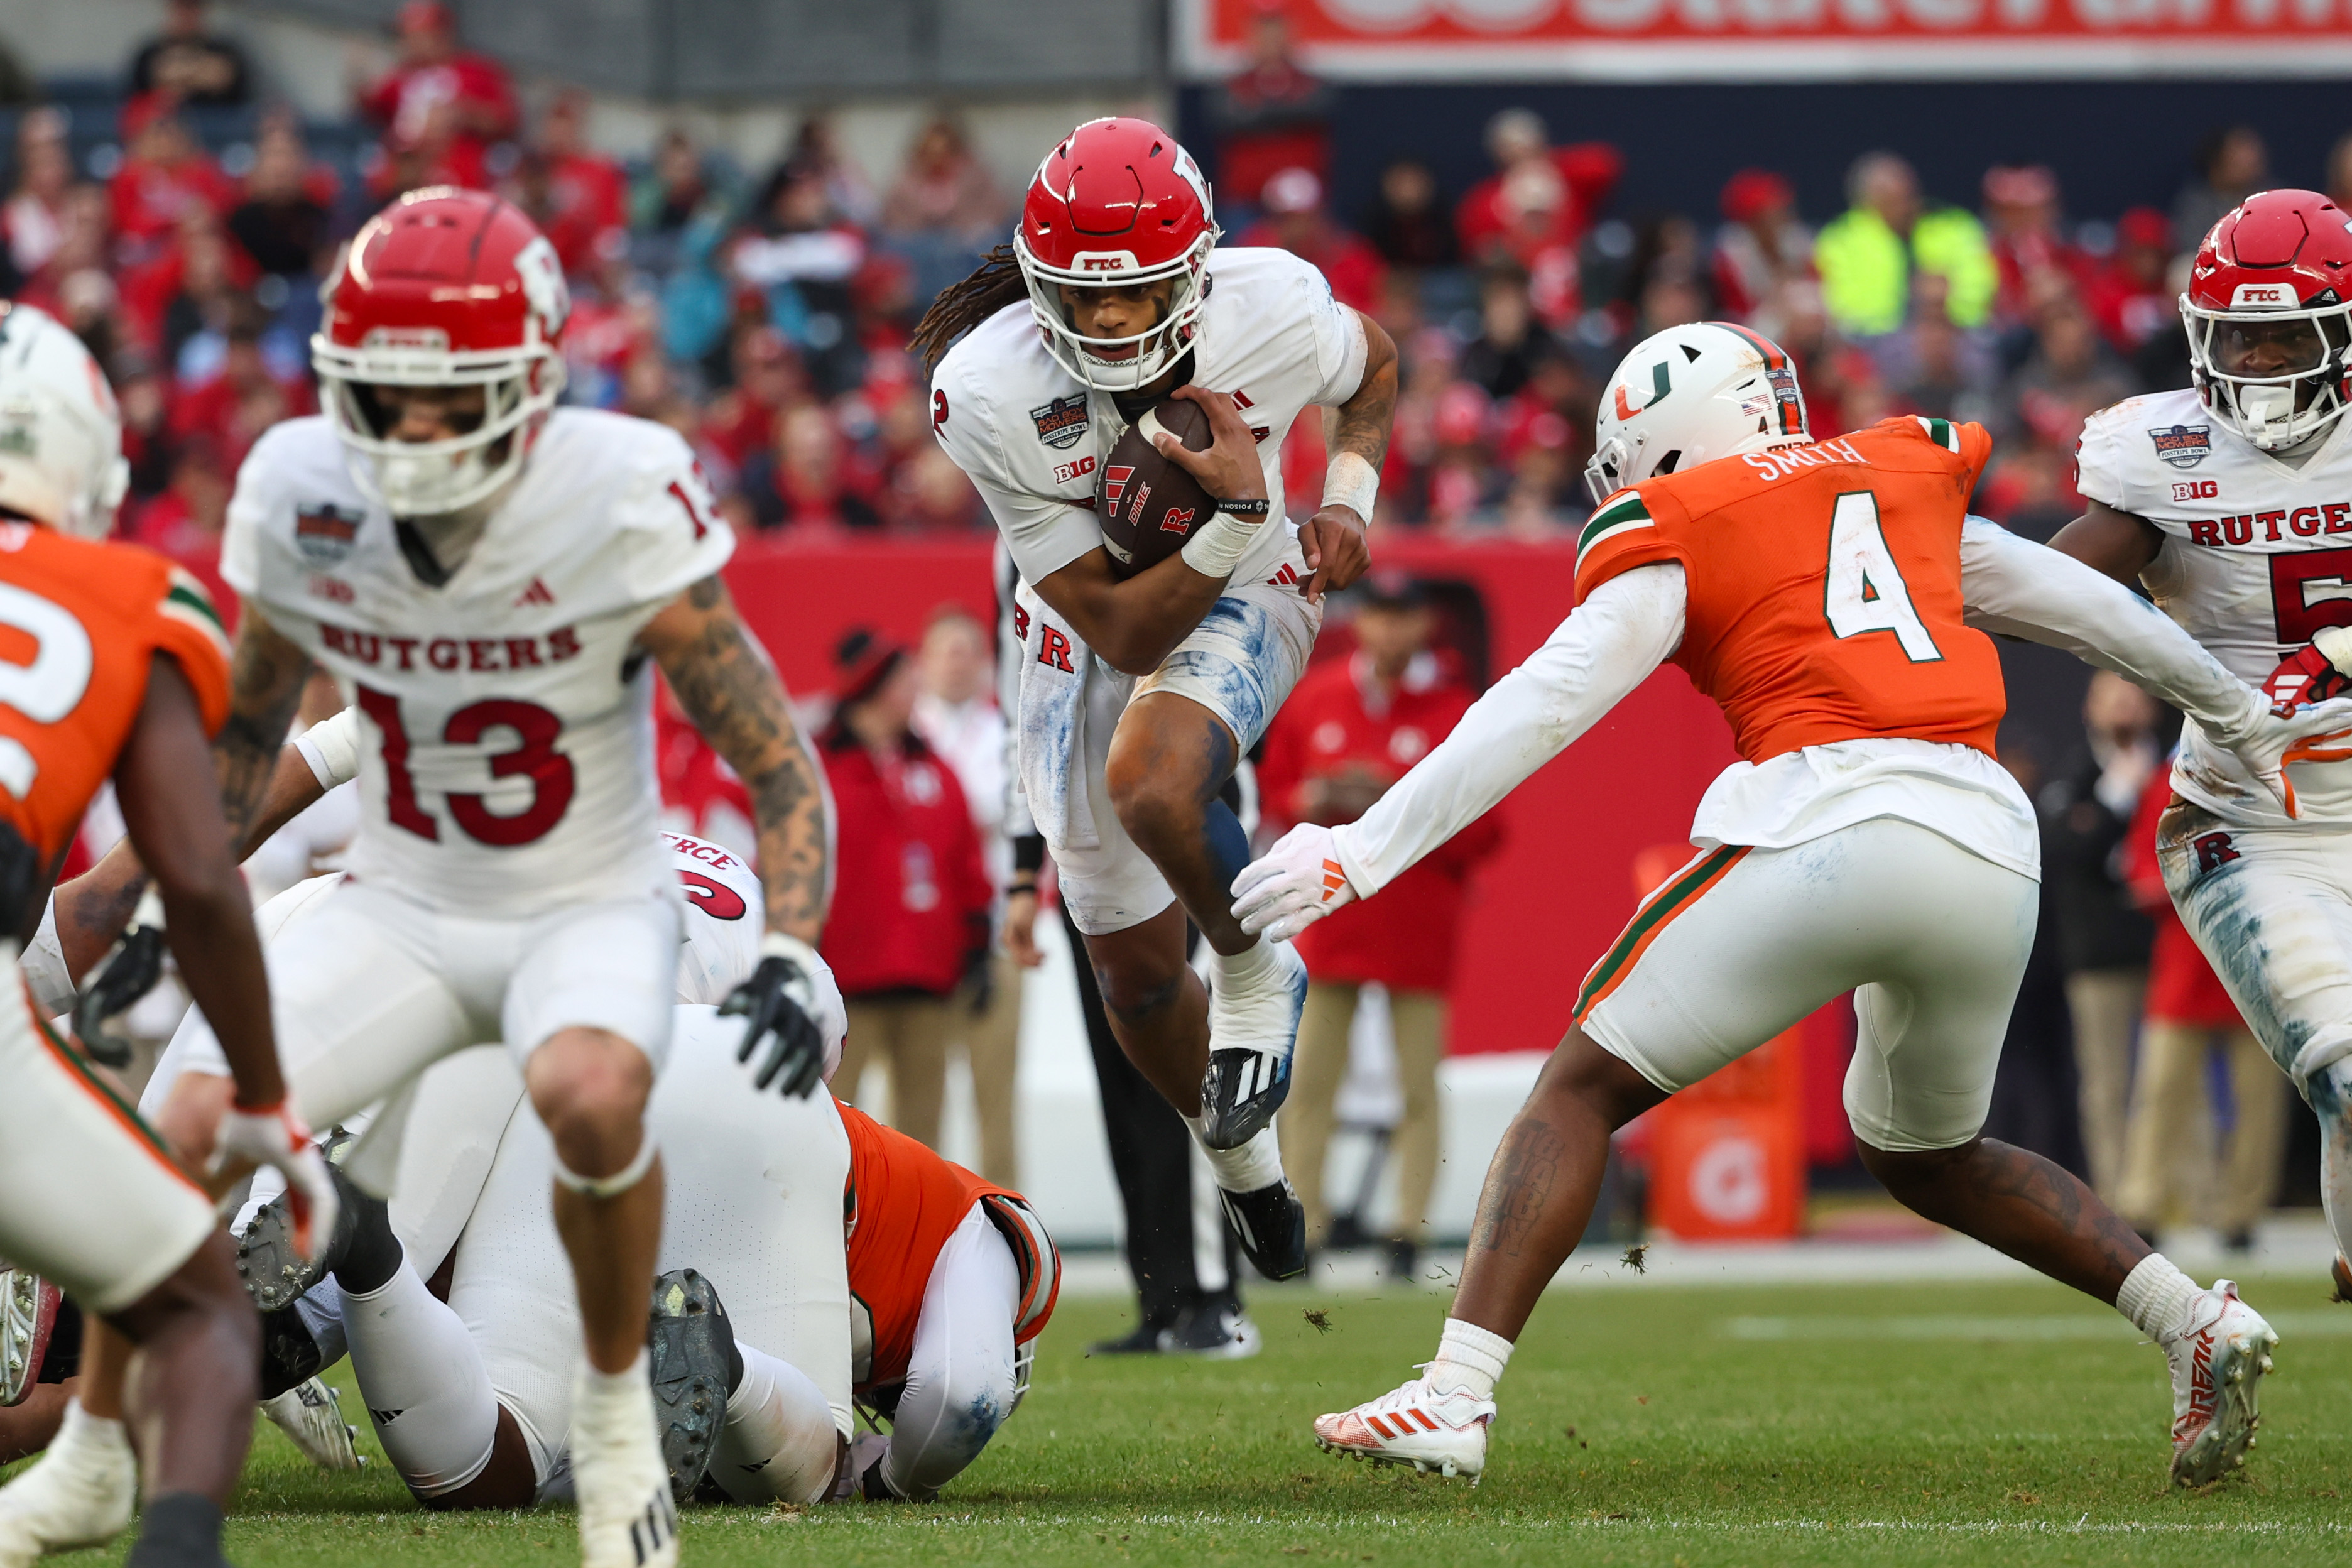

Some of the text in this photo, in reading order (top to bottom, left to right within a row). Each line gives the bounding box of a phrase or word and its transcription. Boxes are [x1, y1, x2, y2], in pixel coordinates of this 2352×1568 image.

[1615, 361, 1672, 421] U
[1038, 406, 1083, 426] BAD BOY
[1040, 413, 1086, 433] MOWERS
[1043, 428, 1069, 442] PINSTRIPE
[1071, 424, 1086, 432] BOWL
[1741, 438, 1871, 481] SMITH
[2157, 439, 2208, 449] MOWERS
[2162, 449, 2188, 458] PINSTRIPE
[1128, 481, 1152, 526] DIME
[1160, 507, 1195, 535] R
[1824, 489, 1946, 664] 4
[319, 622, 583, 672] RUTGERS
[1038, 623, 1074, 674] R
[356, 683, 576, 848] 13
[2194, 832, 2240, 874] R
